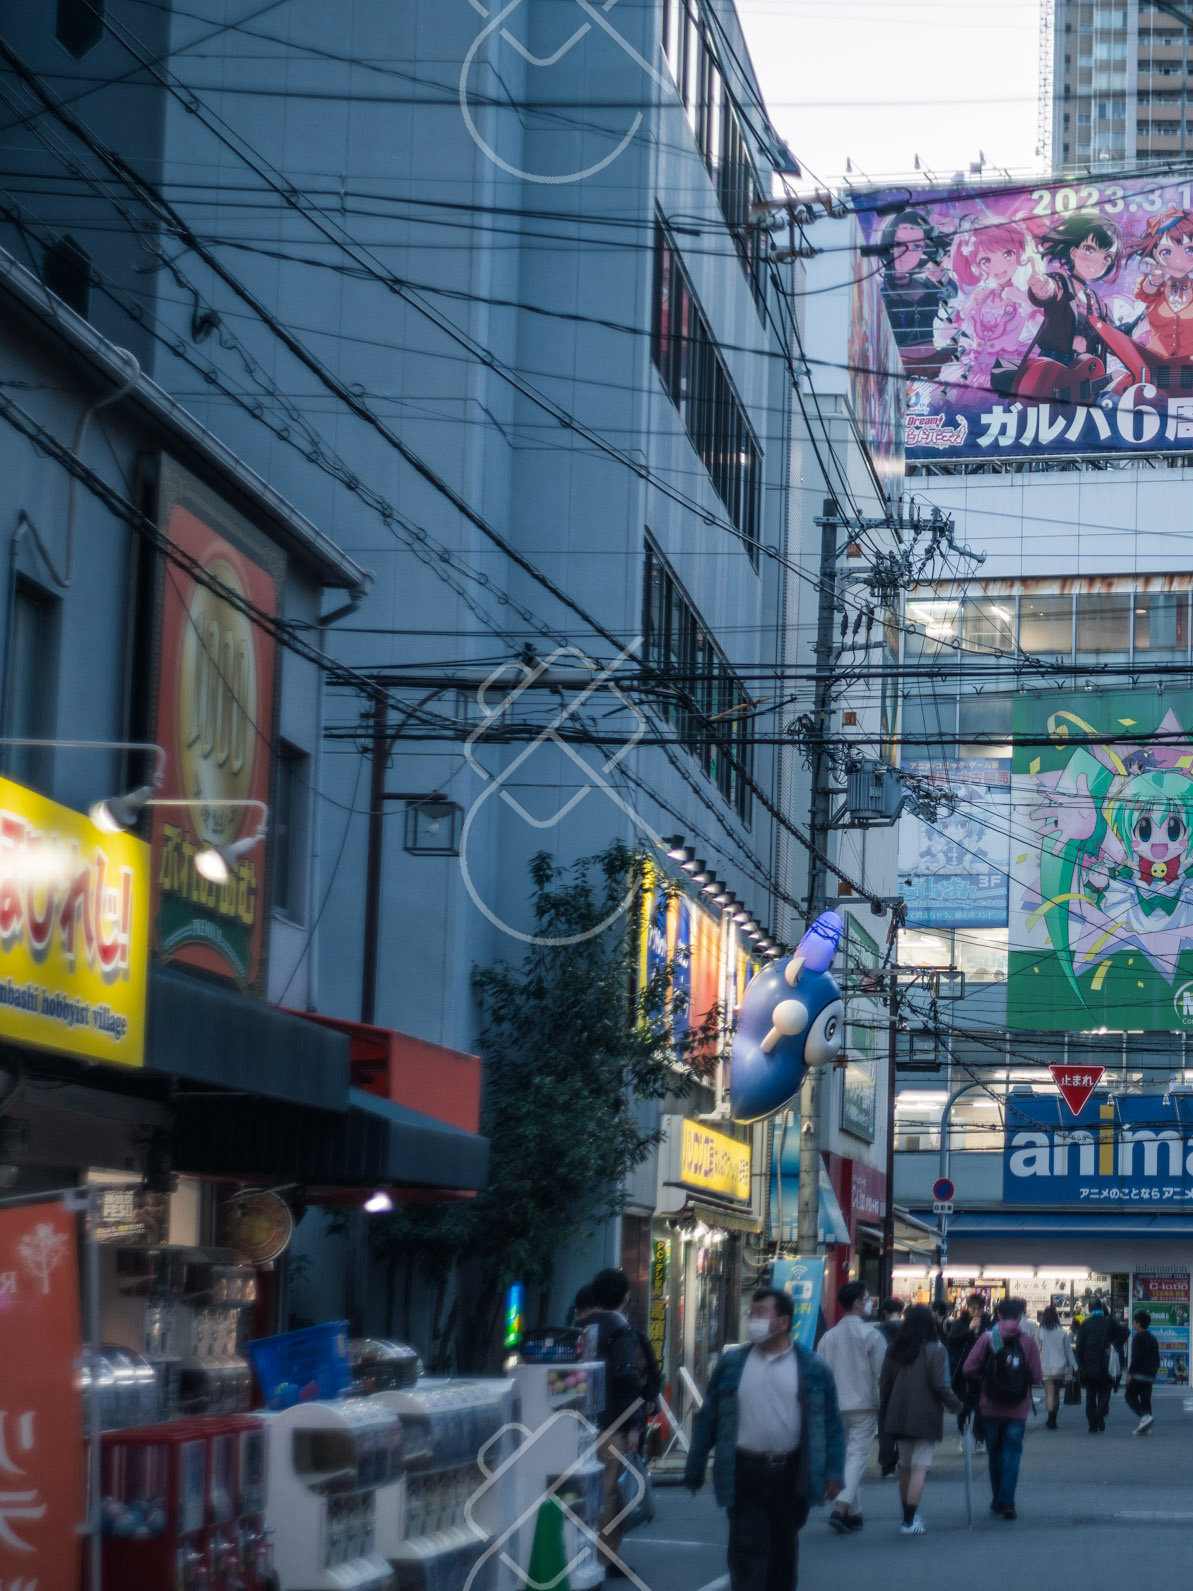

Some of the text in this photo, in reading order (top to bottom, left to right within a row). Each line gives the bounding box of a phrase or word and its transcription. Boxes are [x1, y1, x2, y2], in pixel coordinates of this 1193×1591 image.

[979, 875, 1001, 888] 3F
[41, 988, 90, 1027] hobbyist
[92, 1002, 127, 1039] village
[1061, 1074, 1094, 1087] 止まれ
[1080, 1187, 1161, 1200] アニメのことなら
